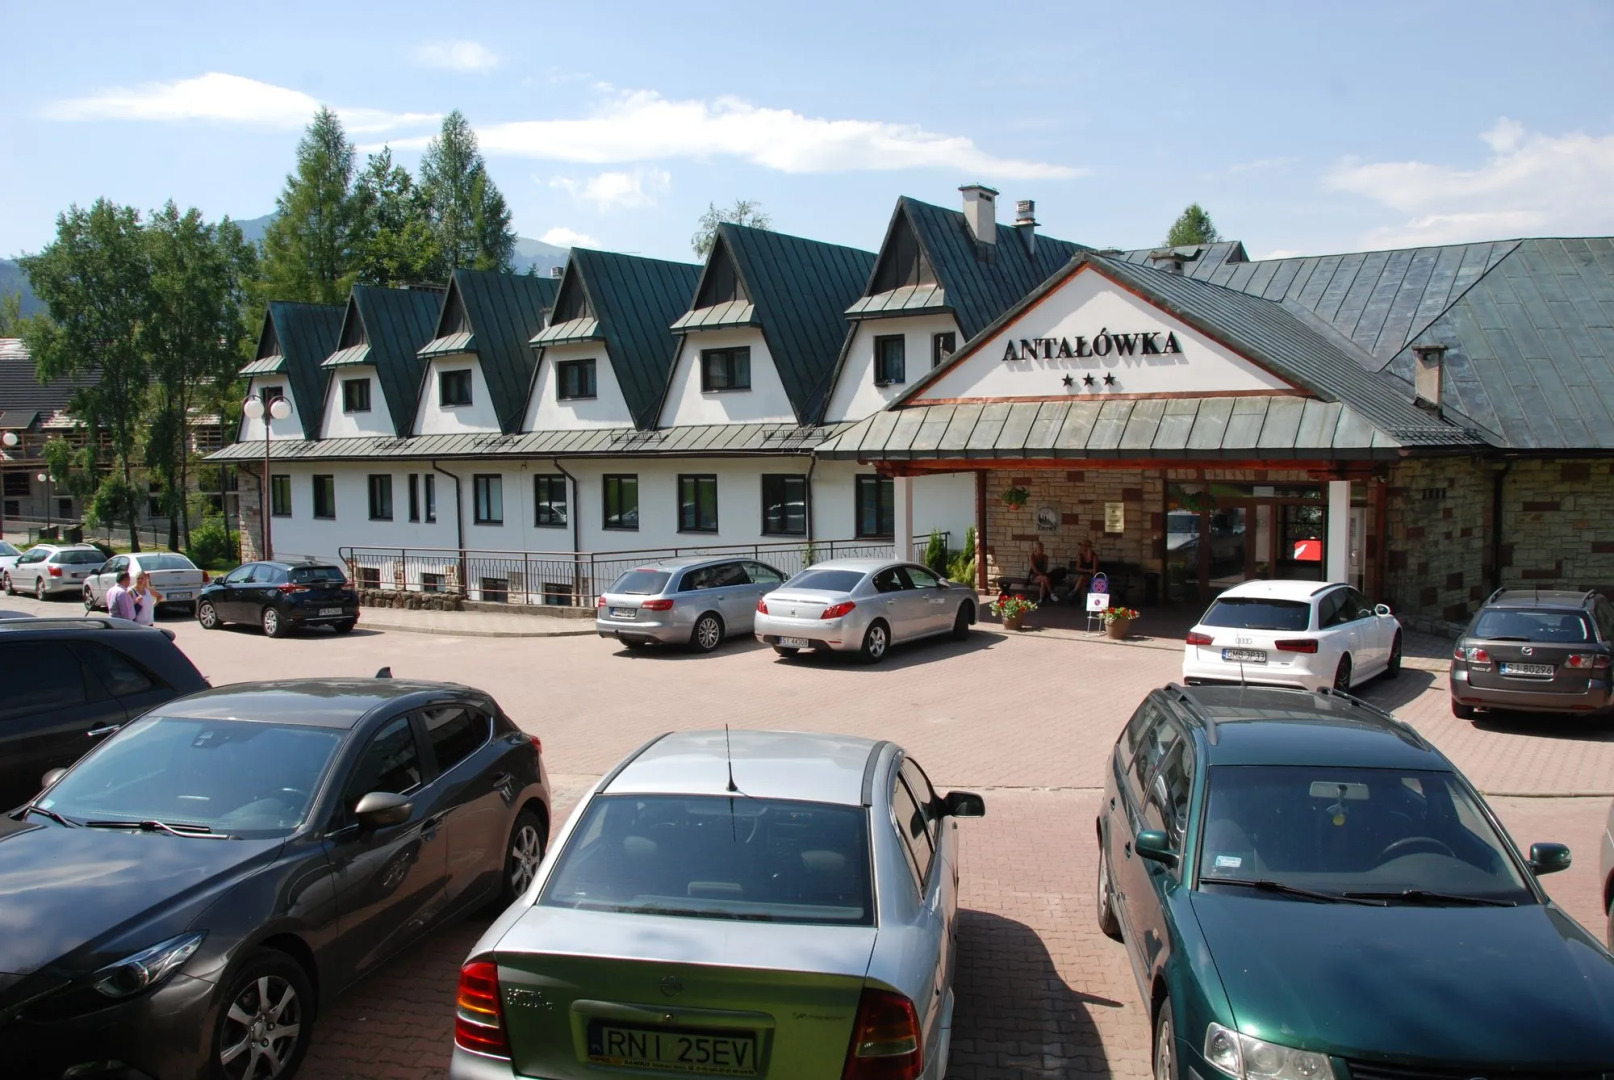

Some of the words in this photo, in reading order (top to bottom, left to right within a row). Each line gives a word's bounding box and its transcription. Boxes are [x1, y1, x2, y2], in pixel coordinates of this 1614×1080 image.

[1002, 327, 1182, 361] ANTAŁÓWKA
[1523, 664, 1553, 675] 80296
[607, 1030, 661, 1061] RNI
[677, 1037, 749, 1067] 25EV
